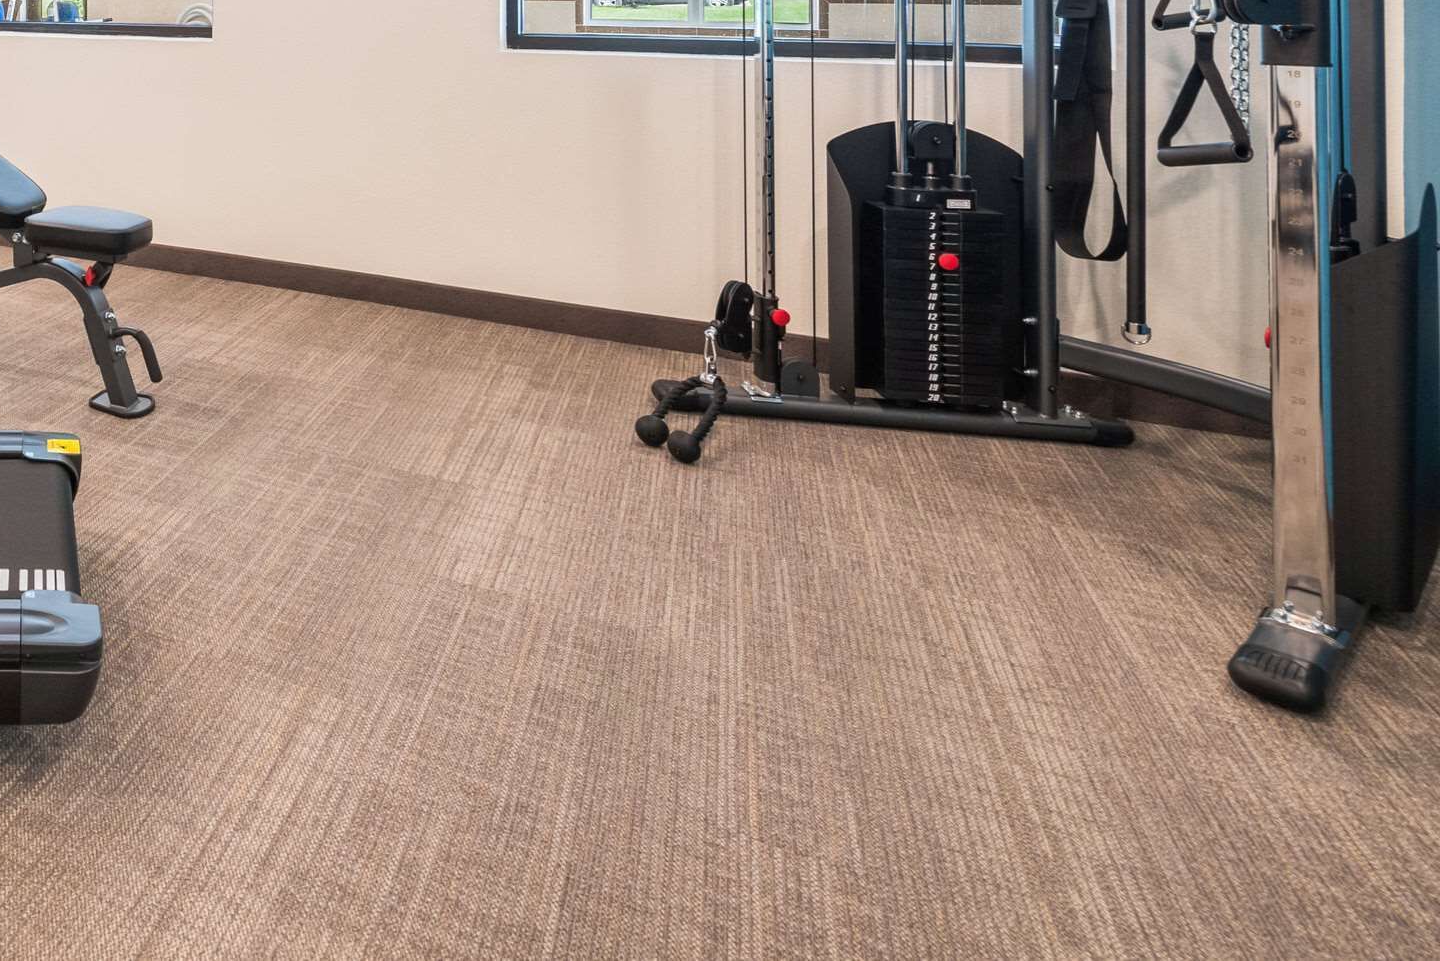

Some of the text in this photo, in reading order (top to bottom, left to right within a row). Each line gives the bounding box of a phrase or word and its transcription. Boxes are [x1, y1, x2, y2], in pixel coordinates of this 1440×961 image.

[928, 211, 937, 220] 2
[928, 222, 937, 230] 3
[929, 233, 937, 241] 4
[928, 242, 937, 250] 5
[928, 253, 936, 261] 6
[929, 262, 936, 271] 7
[928, 273, 937, 281] 8
[930, 283, 938, 291] 9
[928, 292, 938, 300] 10
[927, 303, 936, 311] 11
[927, 313, 938, 321] 12
[928, 323, 939, 331] 13
[928, 334, 939, 342] 14
[928, 353, 938, 361] 16
[928, 363, 939, 371] 17
[928, 383, 939, 391] 19
[927, 393, 940, 401] 20
